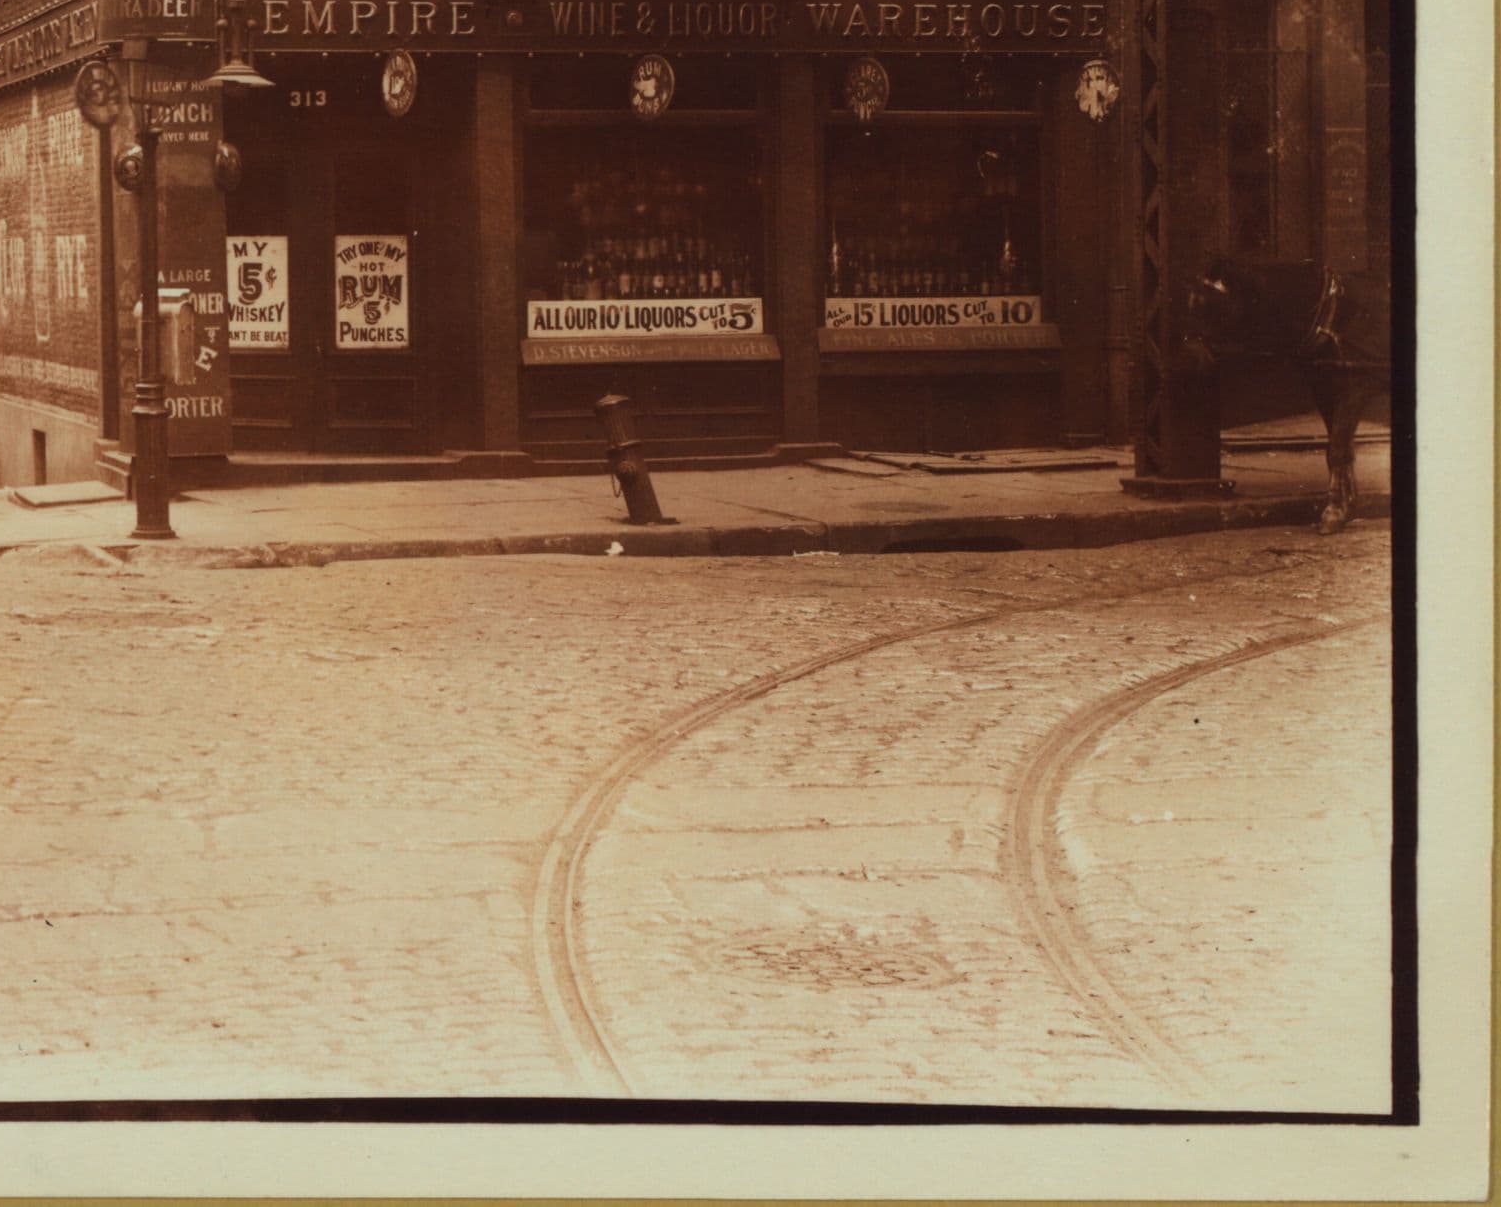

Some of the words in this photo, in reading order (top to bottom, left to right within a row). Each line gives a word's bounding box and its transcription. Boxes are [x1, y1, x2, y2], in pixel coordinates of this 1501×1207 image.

[262, 0, 477, 35] EMPIRE
[550, 1, 626, 37] WINE
[636, 1, 655, 34] &
[668, 1, 778, 39] LIQUOR
[805, 3, 1106, 37] WAREHOUSE
[290, 90, 328, 107] 313
[188, 132, 209, 142] HERE
[233, 242, 267, 257] MY
[337, 245, 357, 265] TRY
[358, 241, 380, 256] ONE
[384, 244, 406, 263] MY
[55, 234, 89, 299] RYE
[360, 262, 385, 272] HOT
[170, 269, 212, 283] LARGE
[338, 274, 403, 310] RUM
[699, 303, 726, 321] CUT
[826, 307, 845, 319] ALL
[963, 299, 988, 318] CUT
[533, 307, 563, 330] ALL
[564, 306, 597, 330] OUR
[625, 305, 697, 332] LIQUORS
[712, 317, 727, 330] TO
[832, 314, 852, 328] OUR
[979, 312, 995, 325] TO
[250, 331, 262, 342] BE
